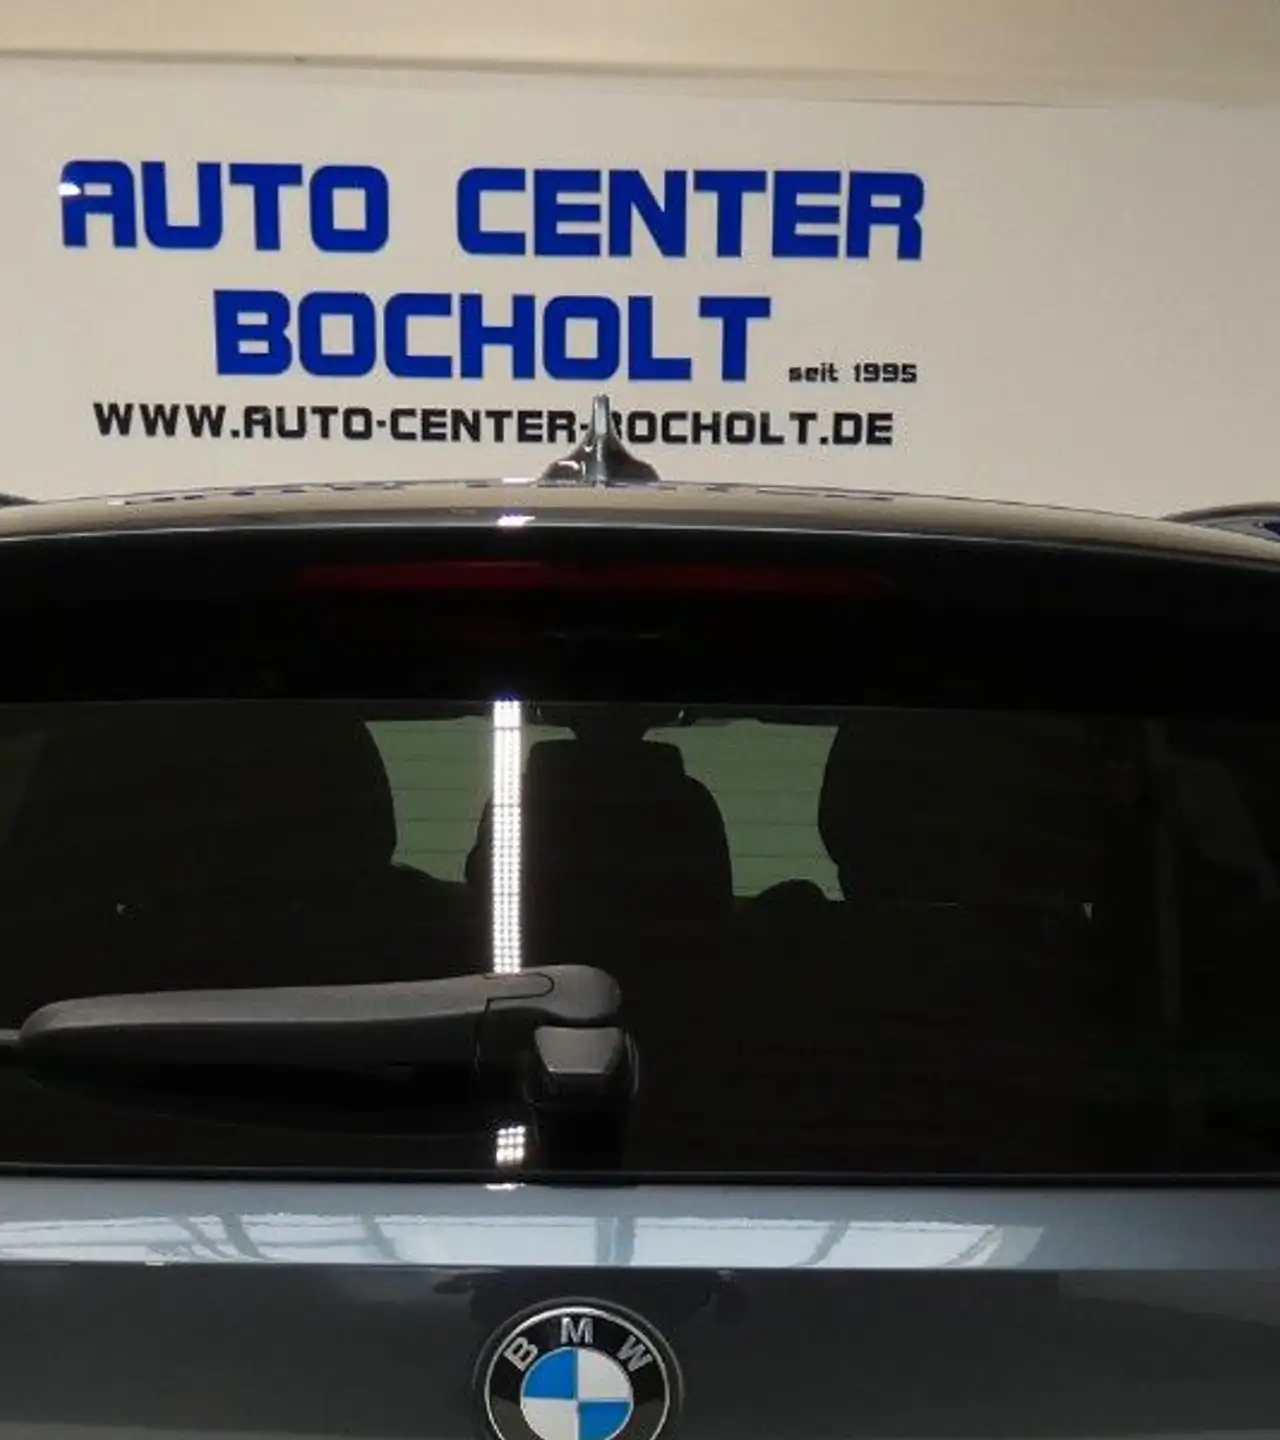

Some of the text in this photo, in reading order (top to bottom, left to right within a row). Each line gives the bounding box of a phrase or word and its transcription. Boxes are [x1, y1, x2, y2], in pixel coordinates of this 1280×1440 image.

[60, 160, 926, 261] AUTO CENTER
[213, 288, 772, 383] BOCHOLT
[787, 362, 918, 384] seit 1995
[503, 1316, 654, 1373] BMW
